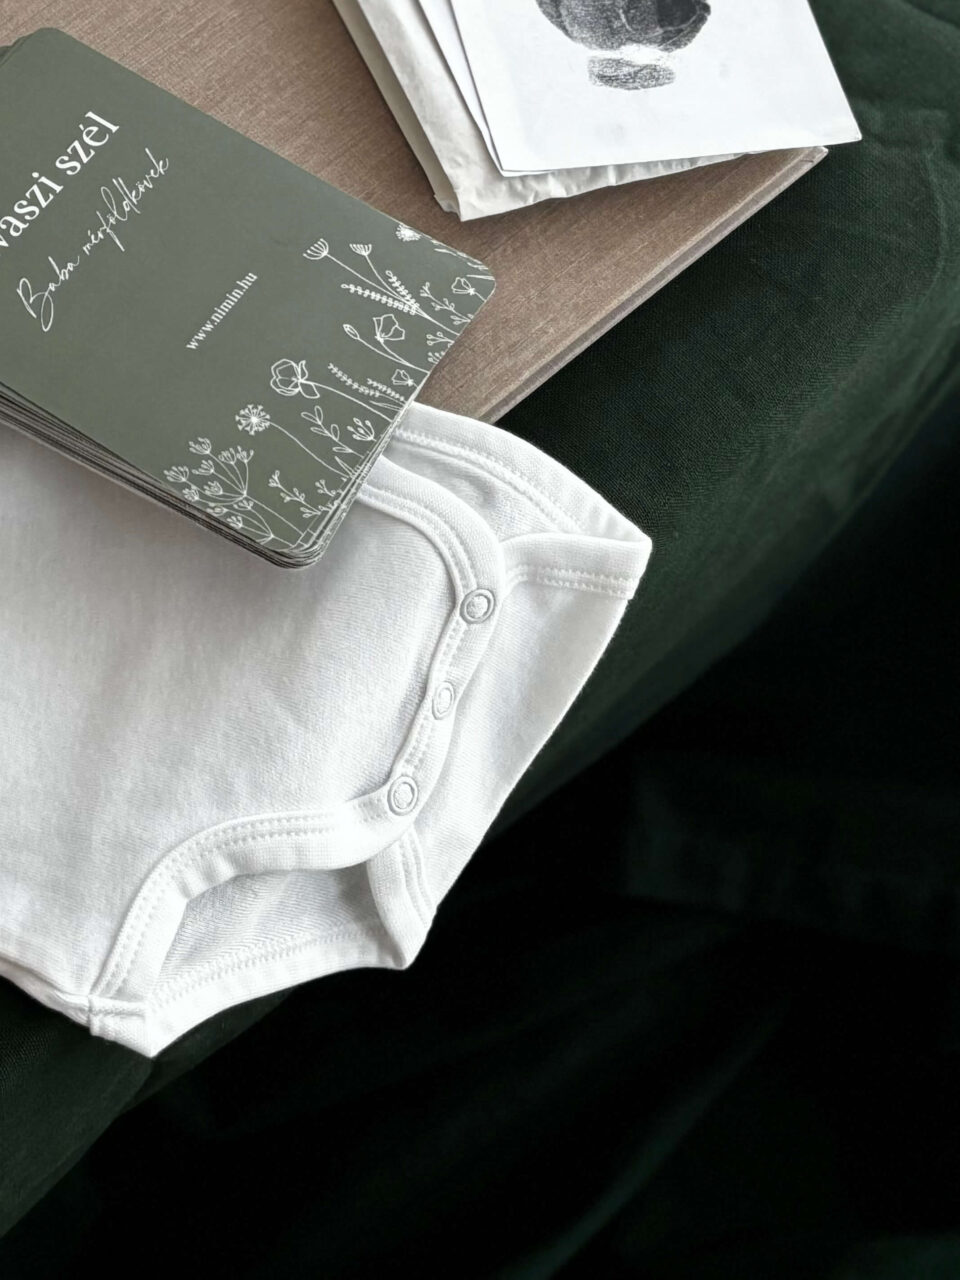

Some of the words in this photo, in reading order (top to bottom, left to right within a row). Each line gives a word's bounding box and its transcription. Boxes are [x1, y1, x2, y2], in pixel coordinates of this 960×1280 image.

[55, 111, 120, 176] szél
[16, 256, 80, 332] Baba
[82, 147, 169, 256] mérföldkövek
[186, 272, 258, 351] www.nimin.hu
